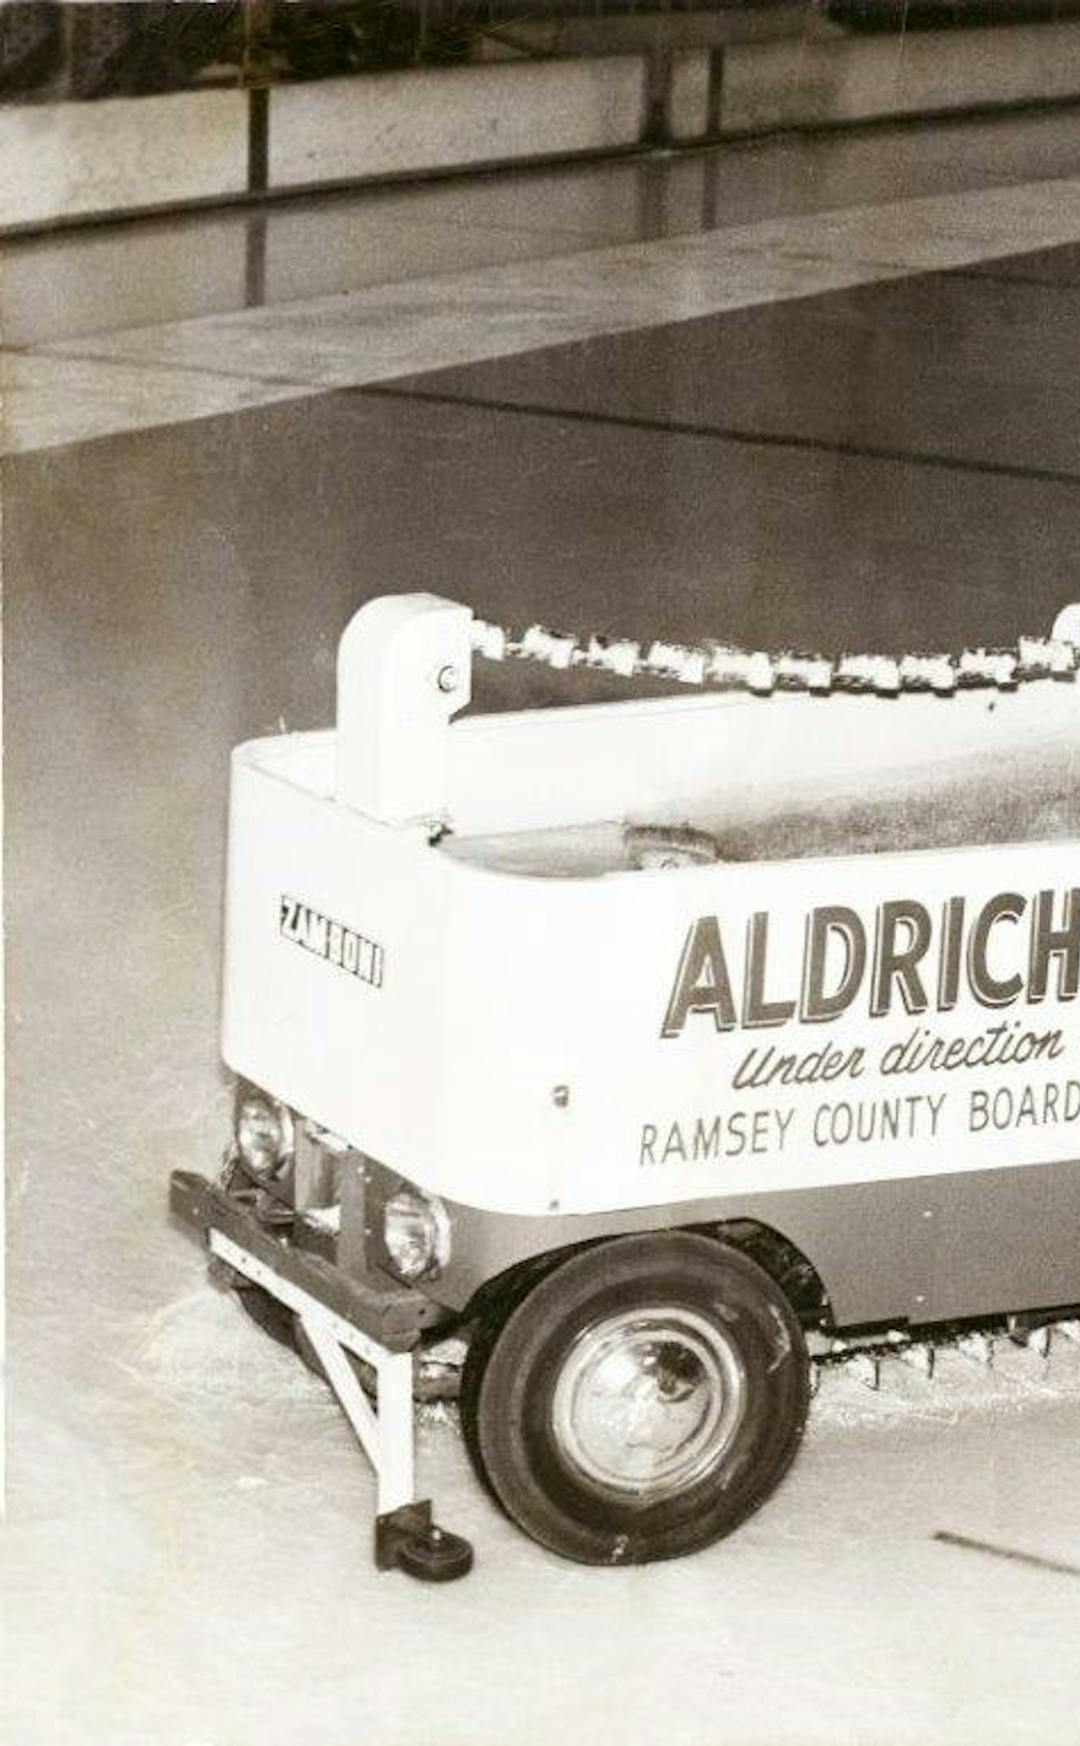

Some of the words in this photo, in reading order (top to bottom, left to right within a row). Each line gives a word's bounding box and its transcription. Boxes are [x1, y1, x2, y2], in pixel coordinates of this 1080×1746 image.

[280, 894, 385, 989] ZAMBONI
[732, 1042, 865, 1090] Under
[880, 1021, 1064, 1075] direction
[640, 1109, 794, 1165] RAMSEY
[814, 1094, 946, 1146] COUNTY
